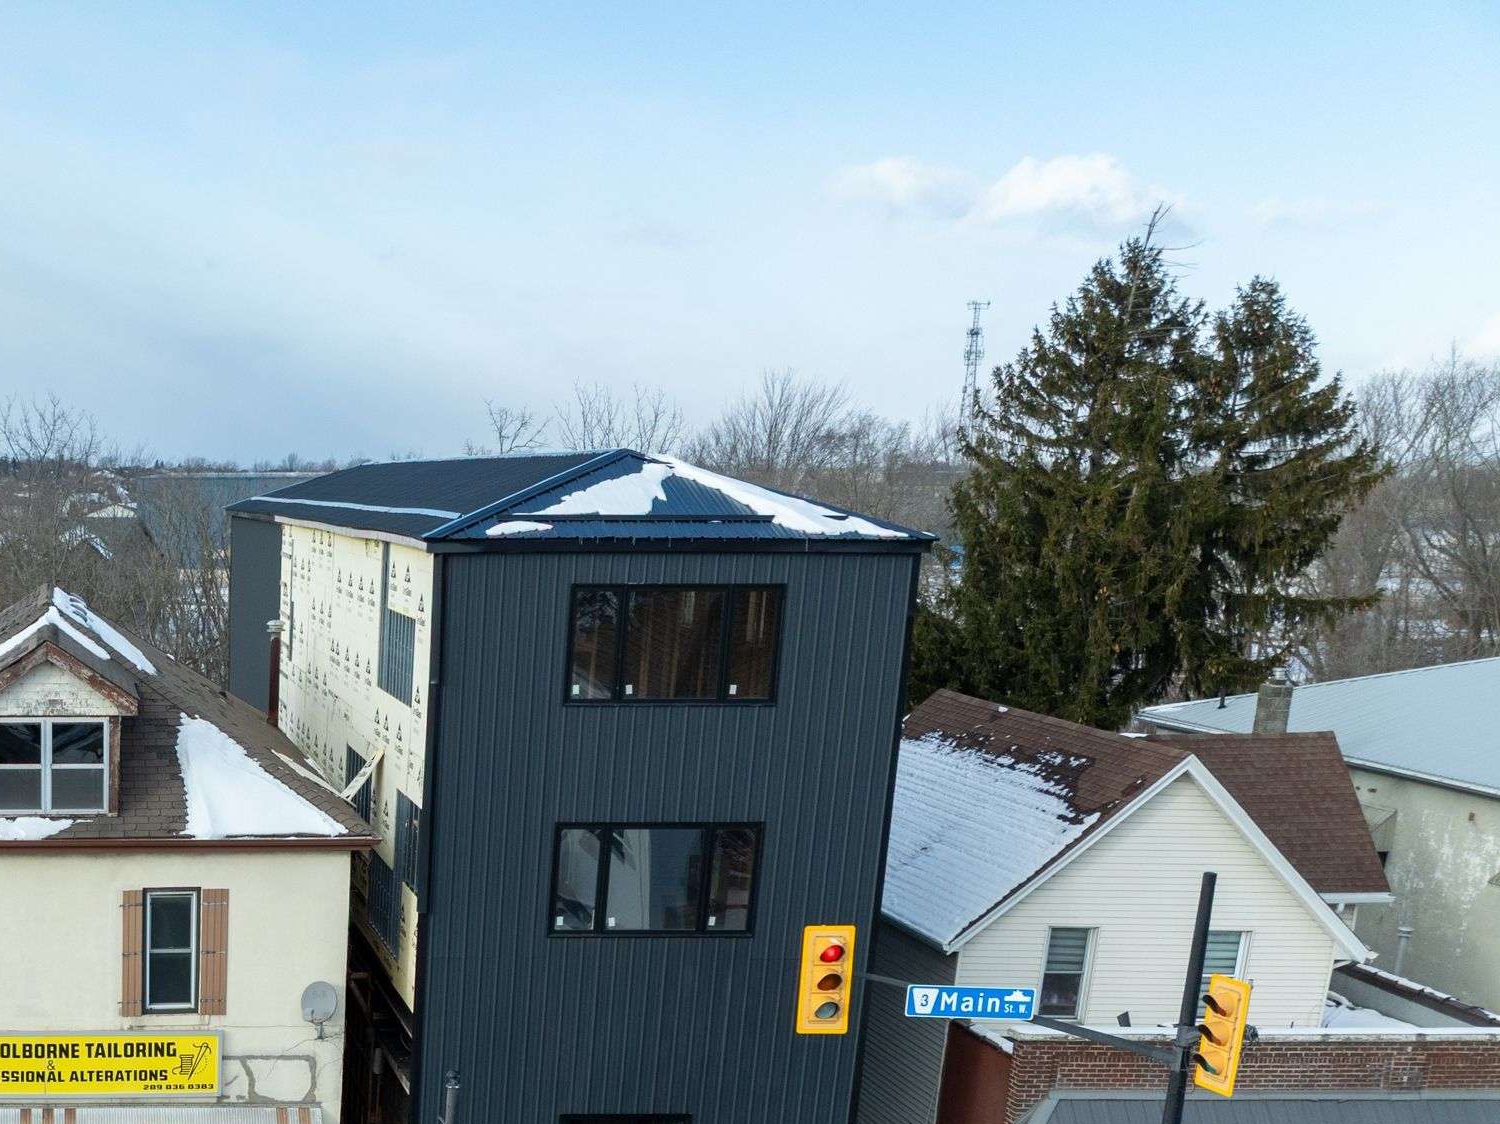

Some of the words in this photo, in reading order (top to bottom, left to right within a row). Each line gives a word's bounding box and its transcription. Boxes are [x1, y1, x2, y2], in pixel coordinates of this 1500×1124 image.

[920, 994, 929, 1007] 3
[940, 992, 1001, 1013] Main
[1004, 1003, 1015, 1014] St.
[85, 1042, 177, 1058] TAILORING
[47, 1060, 56, 1070] &
[69, 1070, 168, 1082] ALTERATIONS
